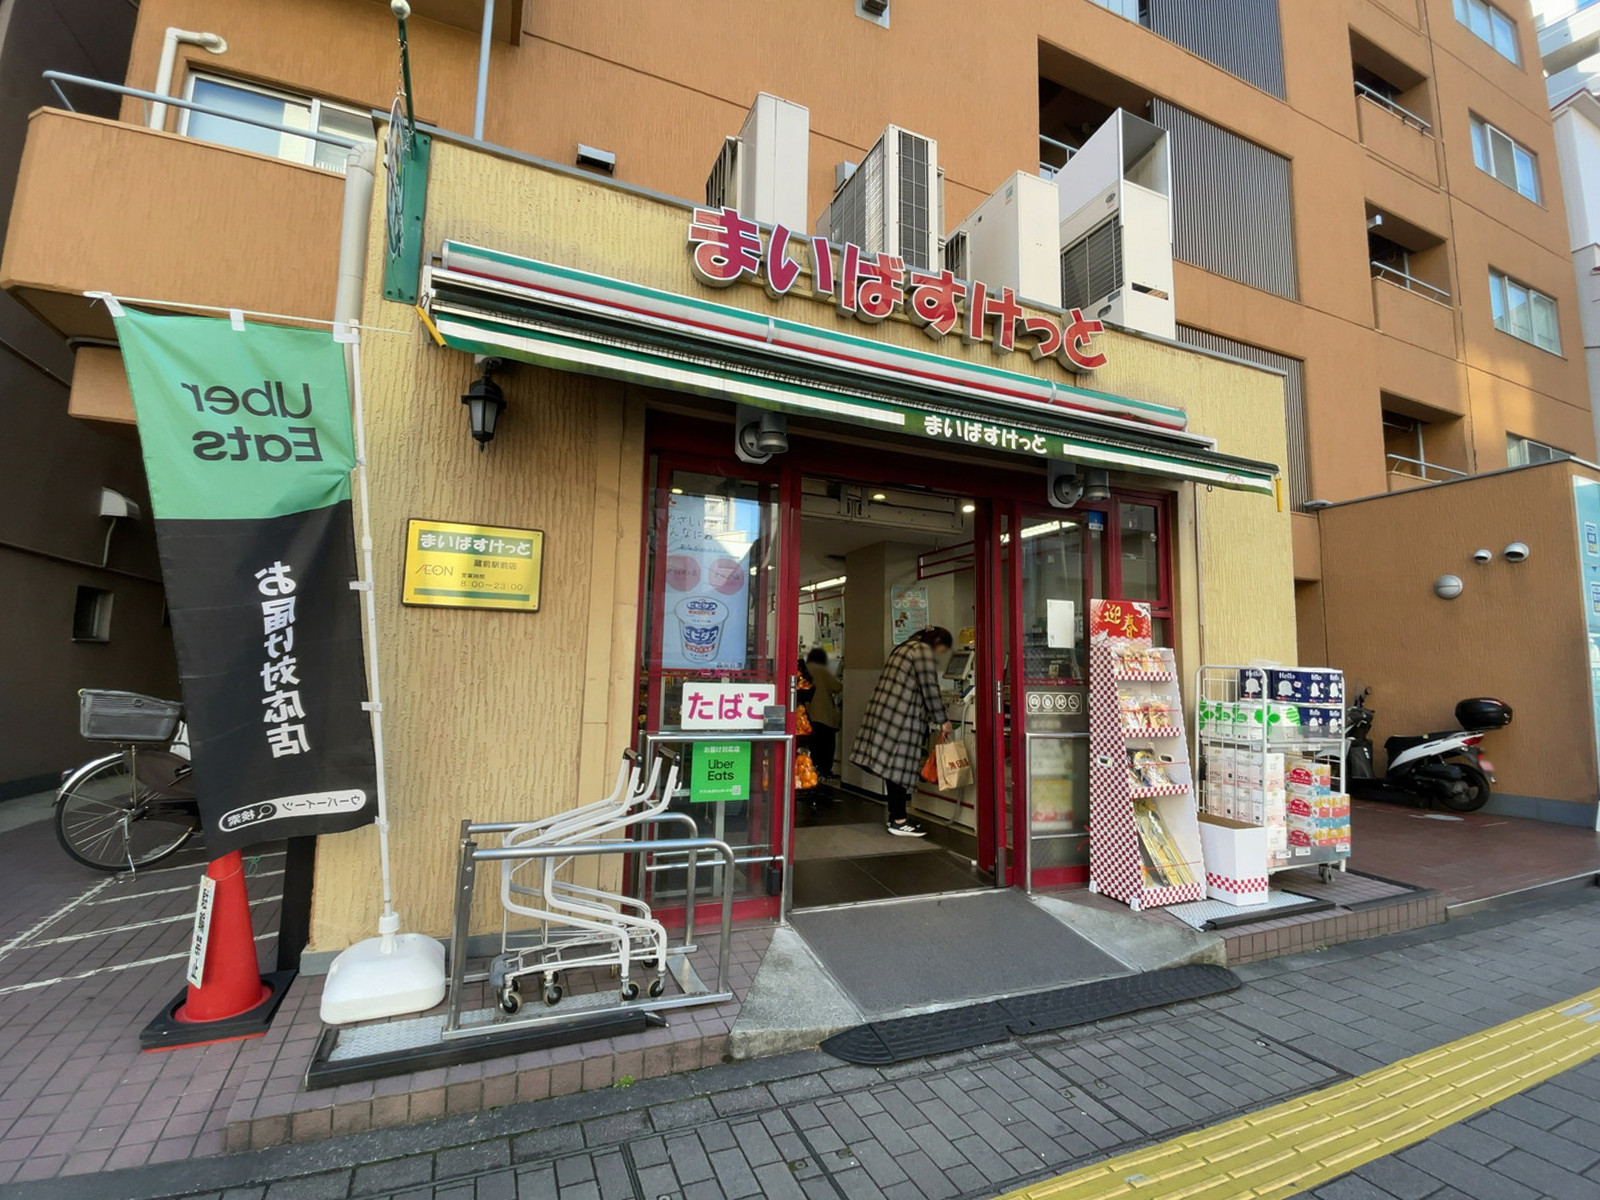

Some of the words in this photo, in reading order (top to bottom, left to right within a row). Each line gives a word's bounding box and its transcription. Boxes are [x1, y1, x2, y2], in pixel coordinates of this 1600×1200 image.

[688, 206, 1109, 372] まいばすけっと
[924, 414, 1048, 455] まいばすけっと
[420, 533, 531, 556] まいばすけっと
[1103, 603, 1140, 640] 迎春
[1279, 672, 1296, 680] Hello
[687, 692, 769, 719] たばこ
[707, 759, 735, 770] Uber
[707, 771, 734, 781] Eats
